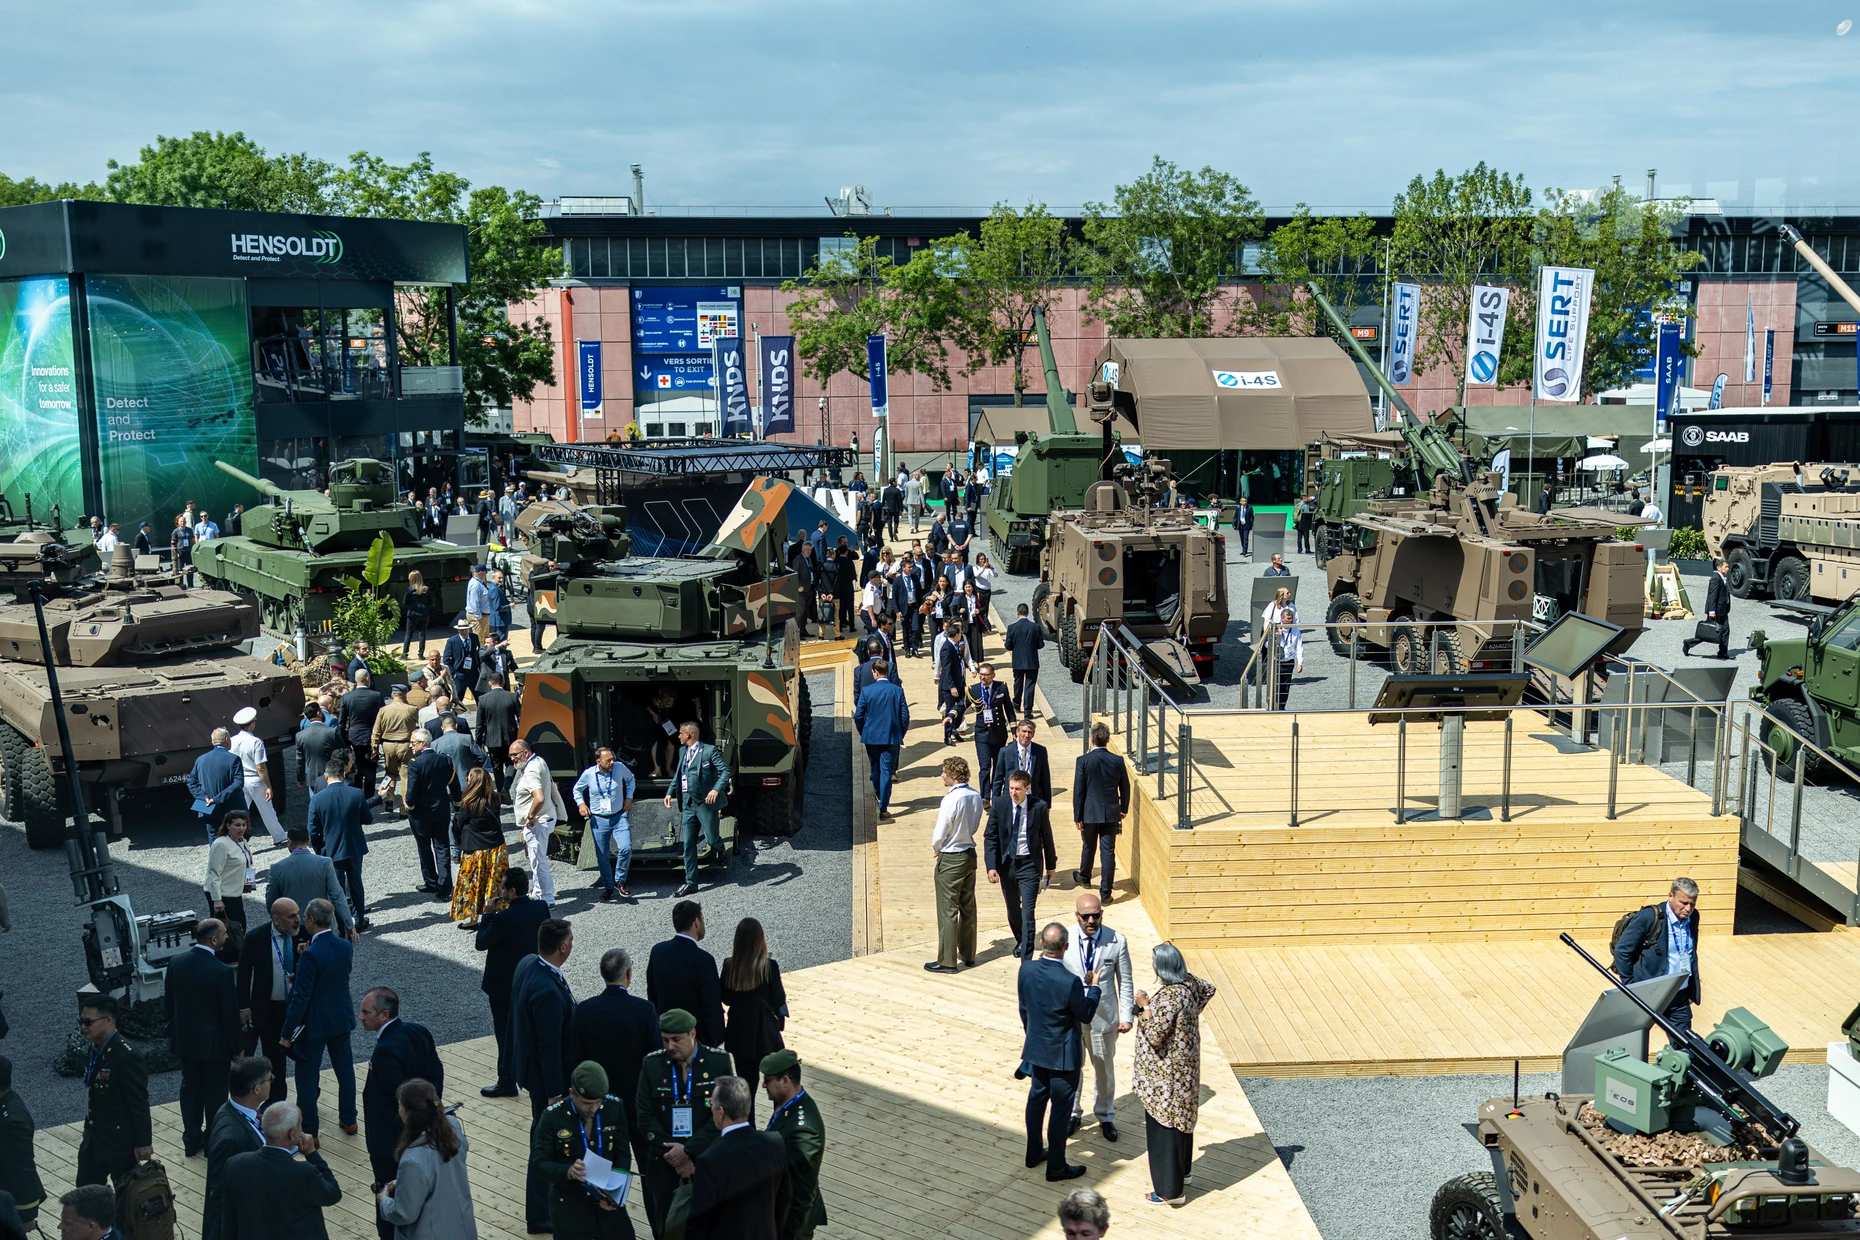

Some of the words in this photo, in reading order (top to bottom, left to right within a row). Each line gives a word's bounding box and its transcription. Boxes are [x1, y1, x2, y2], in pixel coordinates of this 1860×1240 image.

[231, 233, 337, 256] HENSOLDT
[1394, 286, 1411, 354] SERT
[1477, 291, 1502, 345] i-4S
[1545, 271, 1574, 360] SERT
[1566, 336, 1574, 361] LIFE
[1570, 274, 1582, 331] SUPPORT
[1357, 329, 1370, 337] M9
[32, 365, 69, 377] Innovations
[724, 350, 747, 422] KNDS
[770, 349, 789, 421] KNDS
[1240, 375, 1277, 386] i-4S
[39, 381, 48, 393] for
[49, 384, 53, 392] a
[54, 382, 70, 393] safer
[39, 398, 72, 410] tomorrow
[106, 397, 149, 409] Detect
[108, 414, 130, 425] and
[109, 429, 156, 441] Protect
[1705, 431, 1750, 442] SAAB
